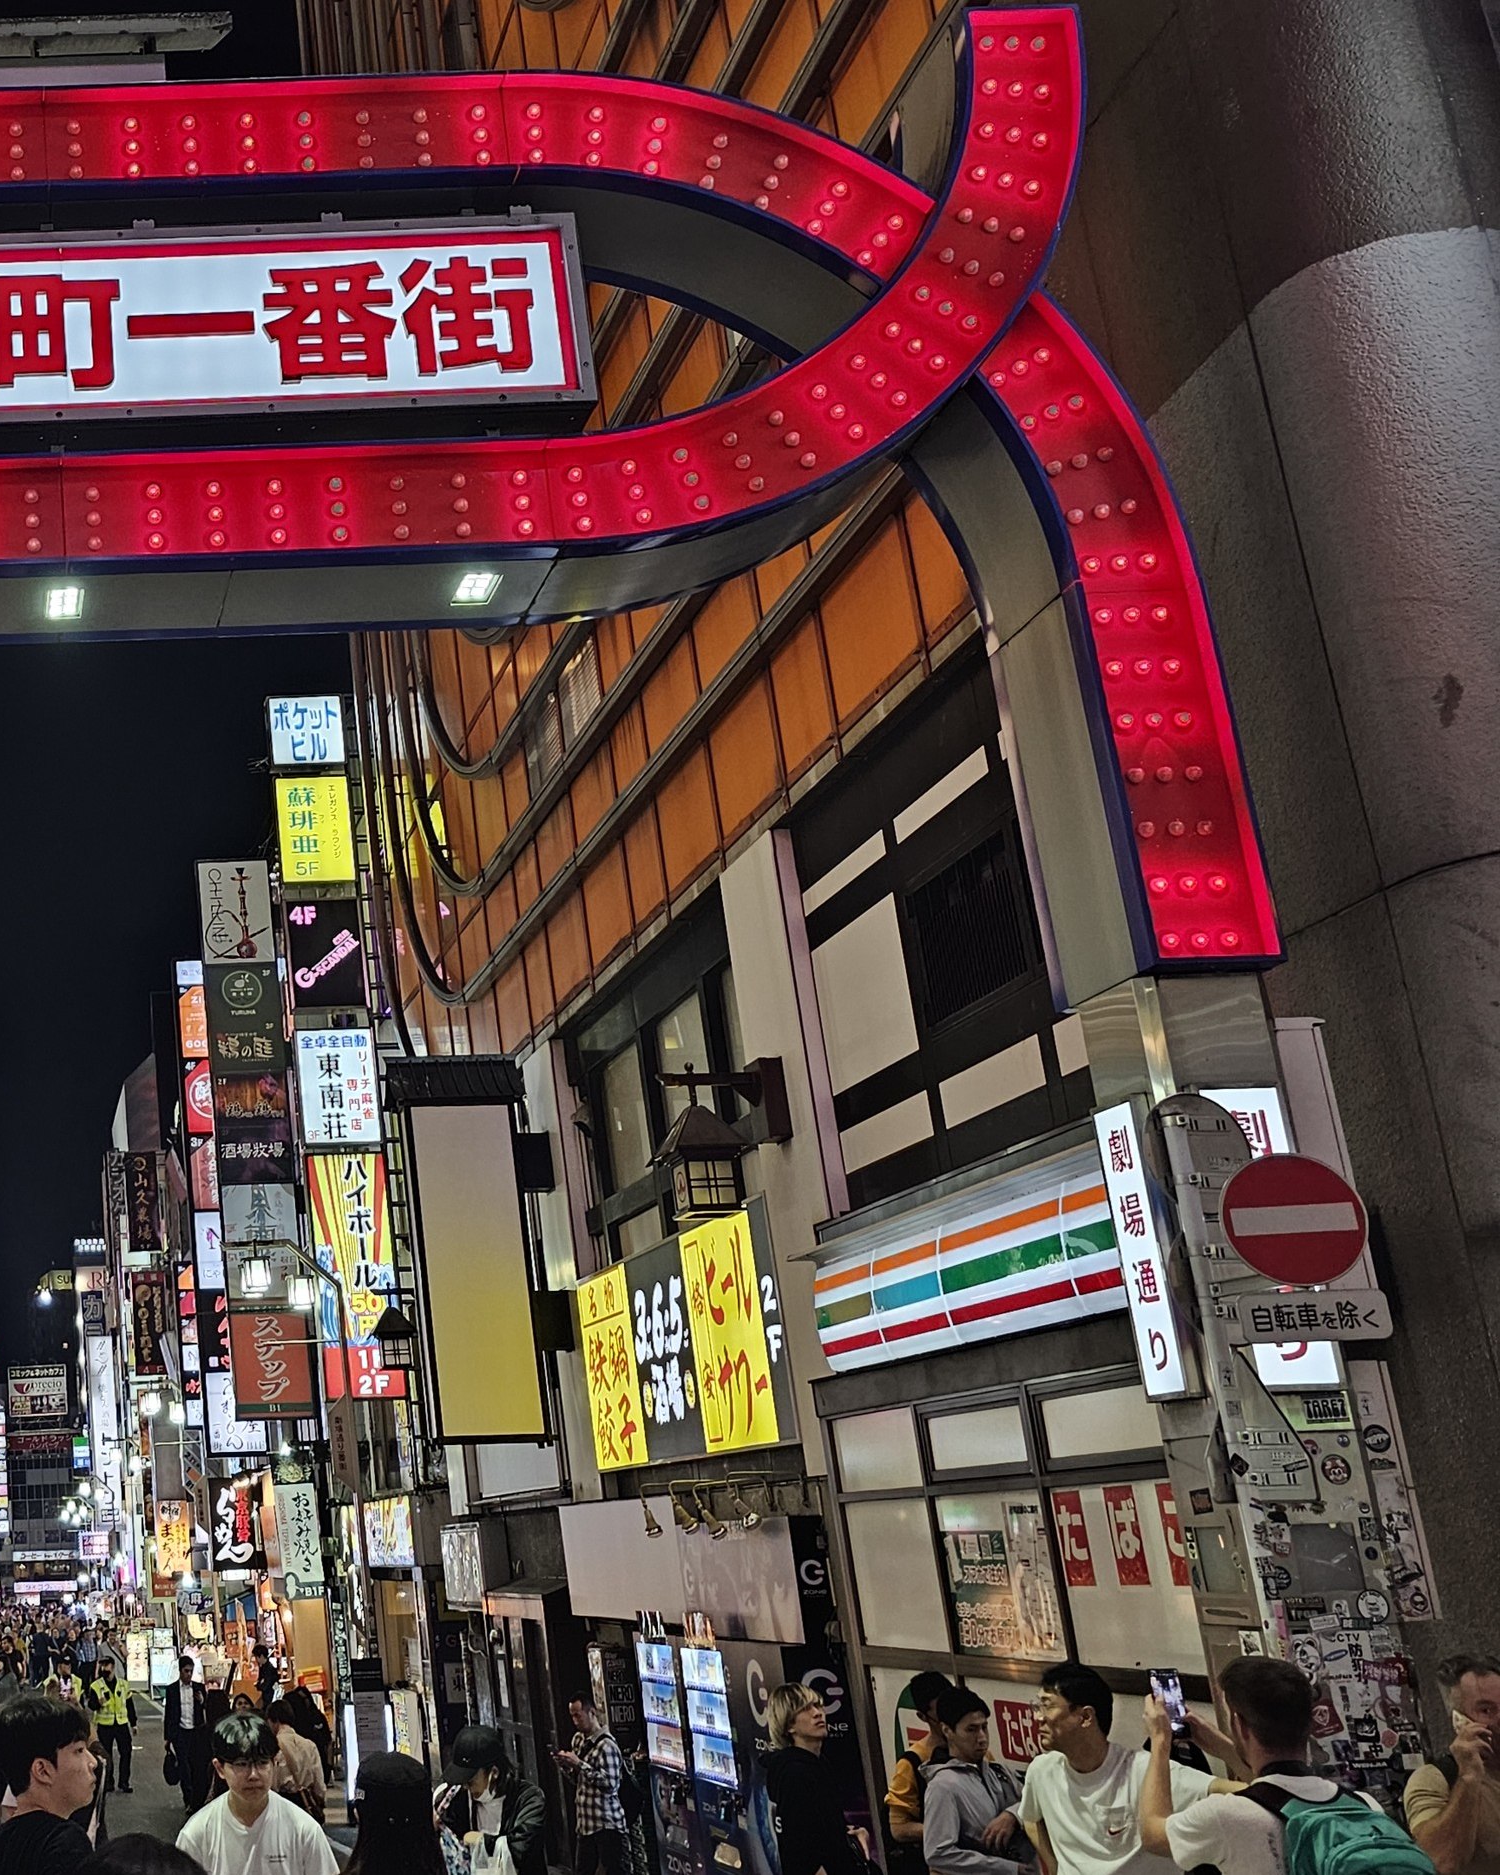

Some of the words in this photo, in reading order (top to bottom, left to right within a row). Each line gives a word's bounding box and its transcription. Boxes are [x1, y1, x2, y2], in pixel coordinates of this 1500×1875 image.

[273, 701, 338, 730] ポケット
[291, 733, 327, 761] ビル
[286, 787, 320, 854] 蘇琲亜
[327, 784, 341, 858] エレガンス・ラウンジ
[295, 862, 319, 875] 5F
[289, 906, 317, 925] 4F
[301, 1035, 367, 1049] 全卓全自動
[316, 1053, 348, 1140] 東南荘
[347, 1079, 362, 1130] 専門店
[357, 1051, 375, 1120] リーチ麻雀
[343, 1158, 377, 1288] ハイボール
[1107, 1125, 1169, 1372] 劇場通り
[588, 1277, 615, 1318] 名物
[701, 1224, 752, 1326] ビール
[760, 1274, 783, 1364] 2F
[1250, 1299, 1380, 1333] 自転車を除く
[252, 1316, 290, 1401] ステップ
[359, 1375, 390, 1395] 2F
[589, 1325, 630, 1395] 鉄鍋
[717, 1344, 768, 1441] サワー
[597, 1393, 637, 1464] 餃子
[292, 1492, 318, 1572] お好み焼き
[305, 1586, 325, 1596] B1F
[1002, 1706, 1043, 1757] たば
